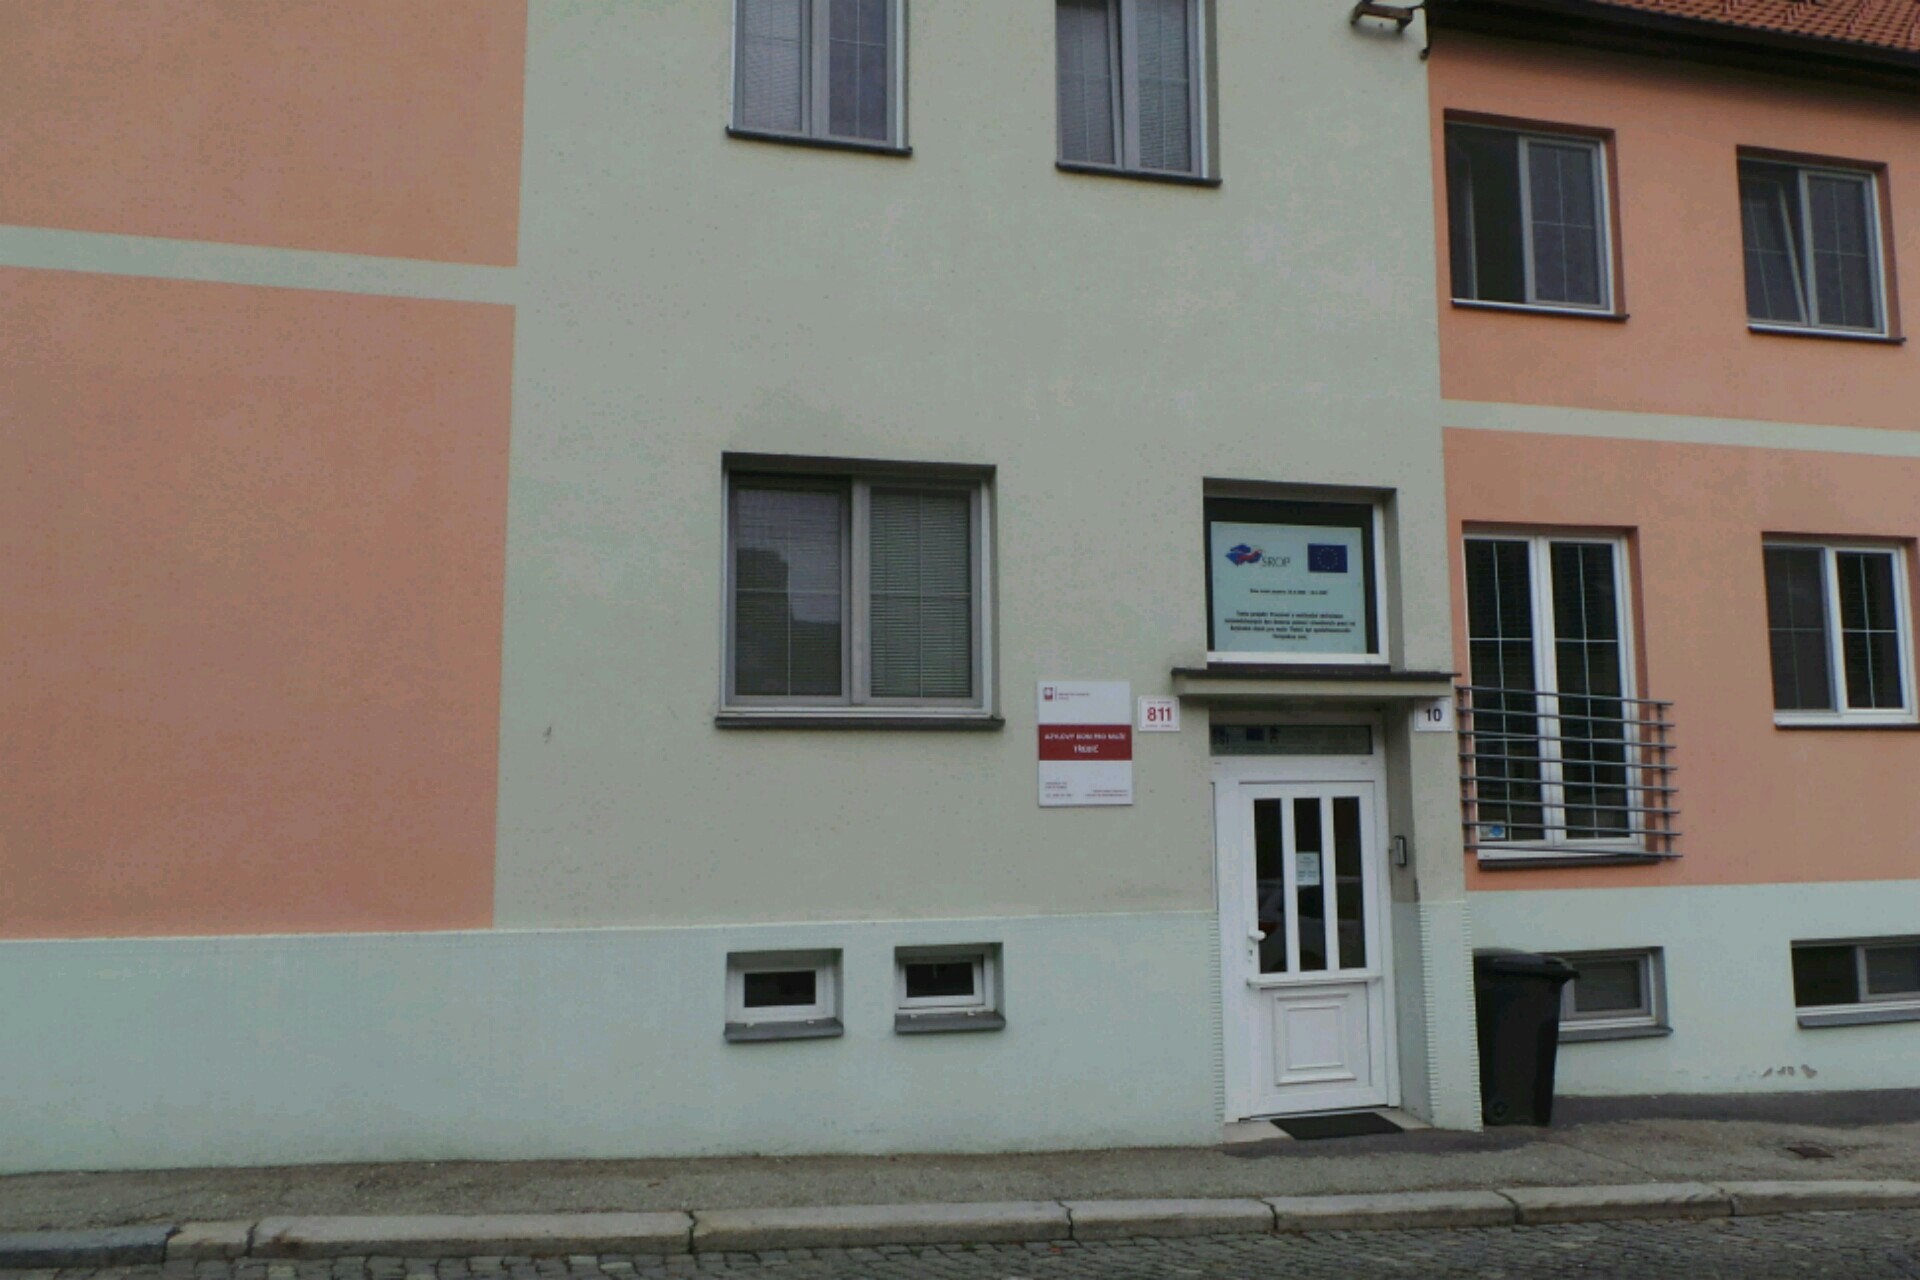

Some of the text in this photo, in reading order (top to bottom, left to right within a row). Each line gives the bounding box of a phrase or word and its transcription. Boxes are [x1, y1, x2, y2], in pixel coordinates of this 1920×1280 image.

[1262, 556, 1291, 568] SROP
[1147, 706, 1172, 722] 811
[1425, 708, 1443, 722] 10
